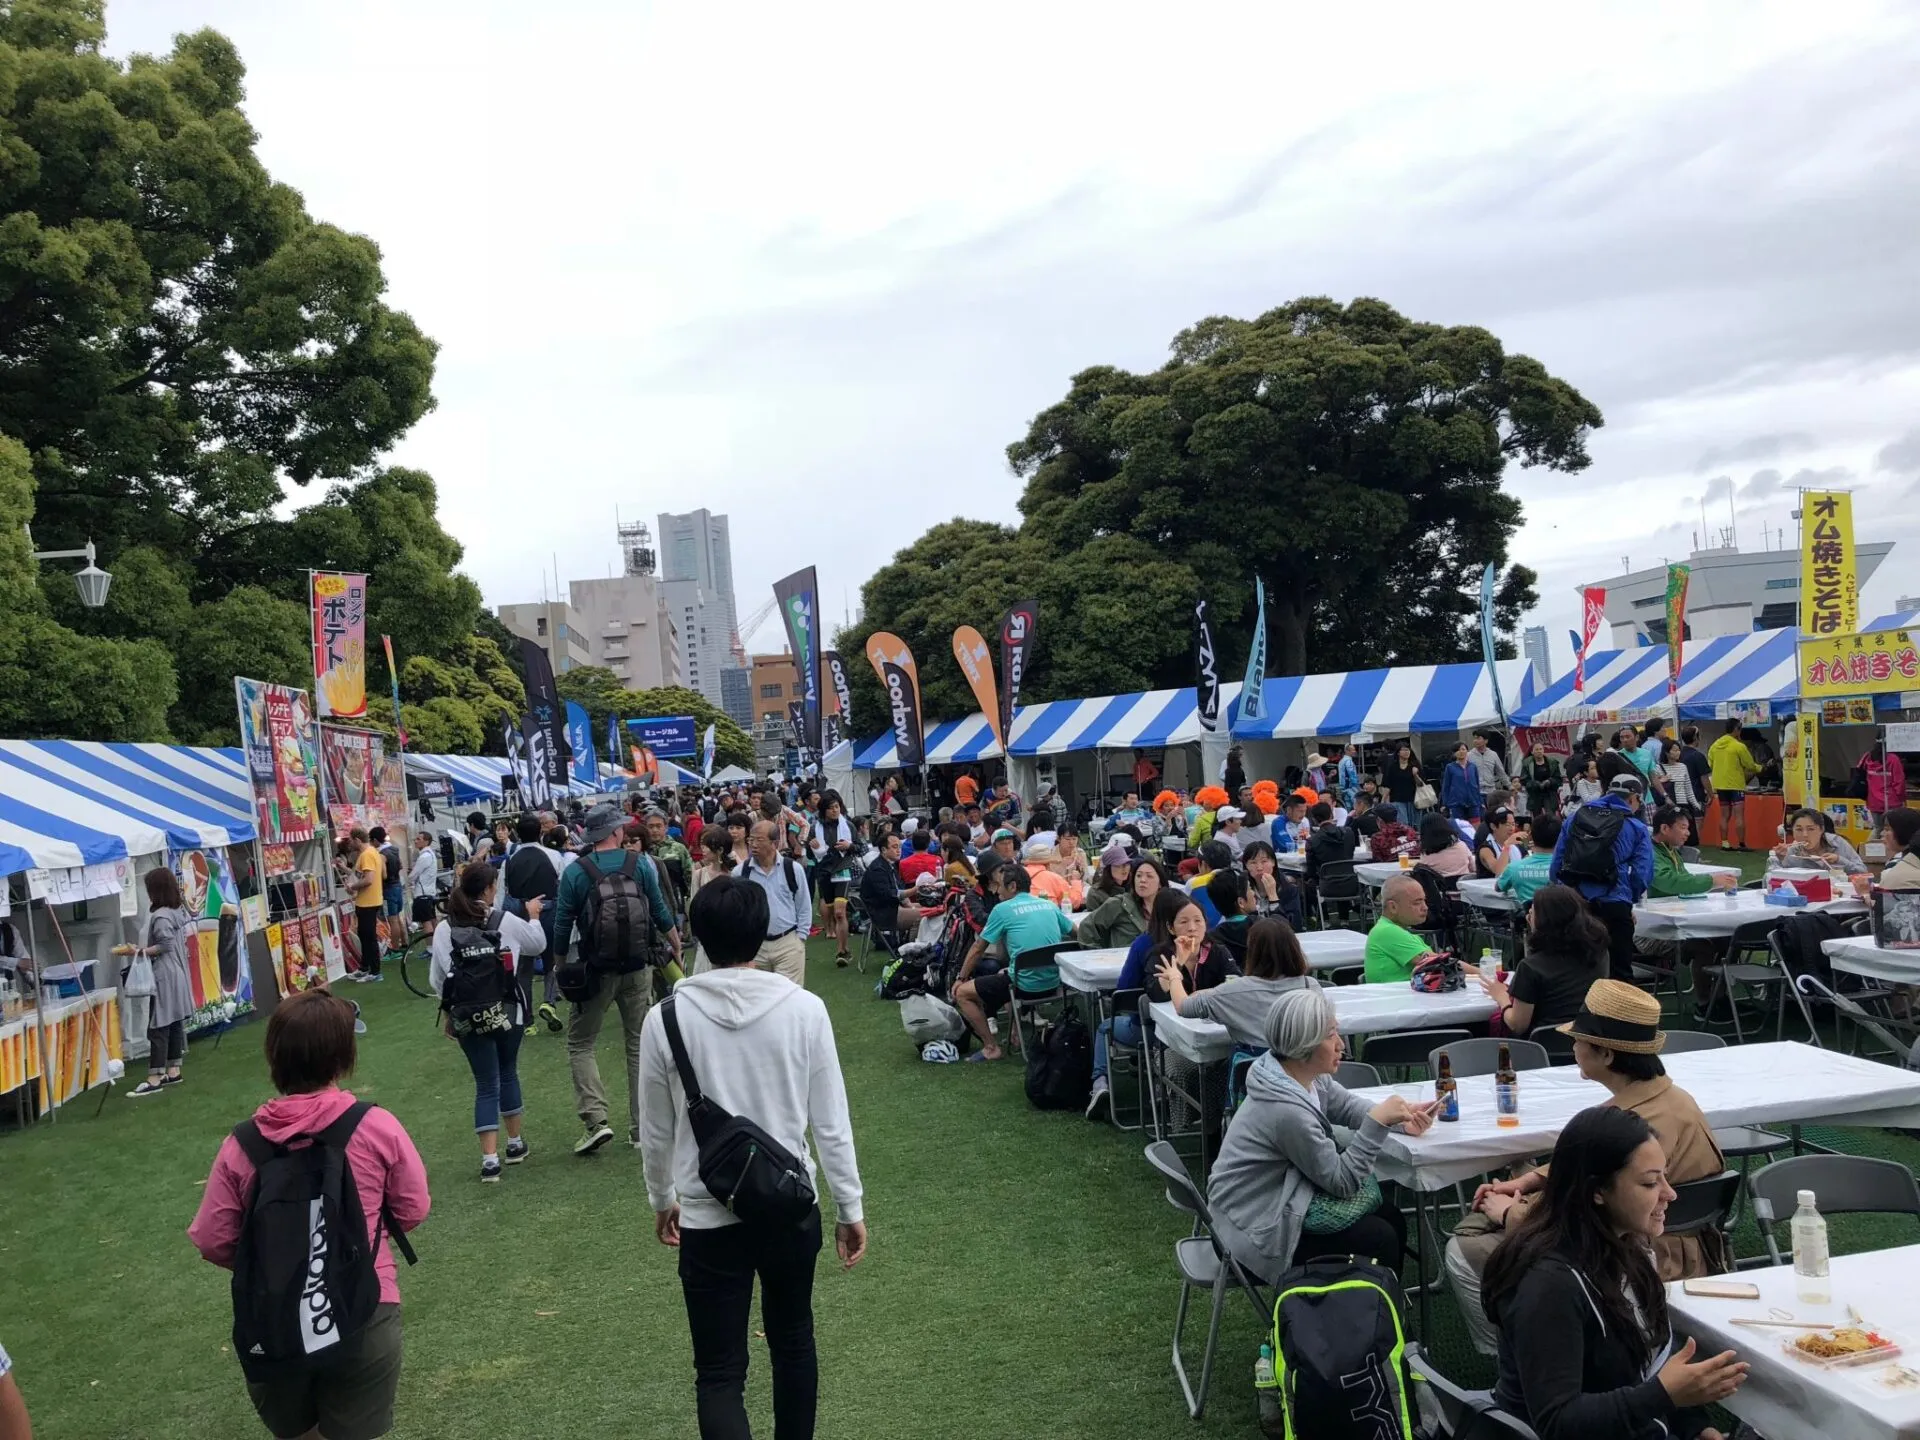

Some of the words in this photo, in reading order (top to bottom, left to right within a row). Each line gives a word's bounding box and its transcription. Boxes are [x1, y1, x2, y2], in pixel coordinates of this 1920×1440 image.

[1811, 496, 1842, 634] オム焼きそば
[323, 598, 347, 670] ポテト
[644, 728, 679, 736] ミュージカル
